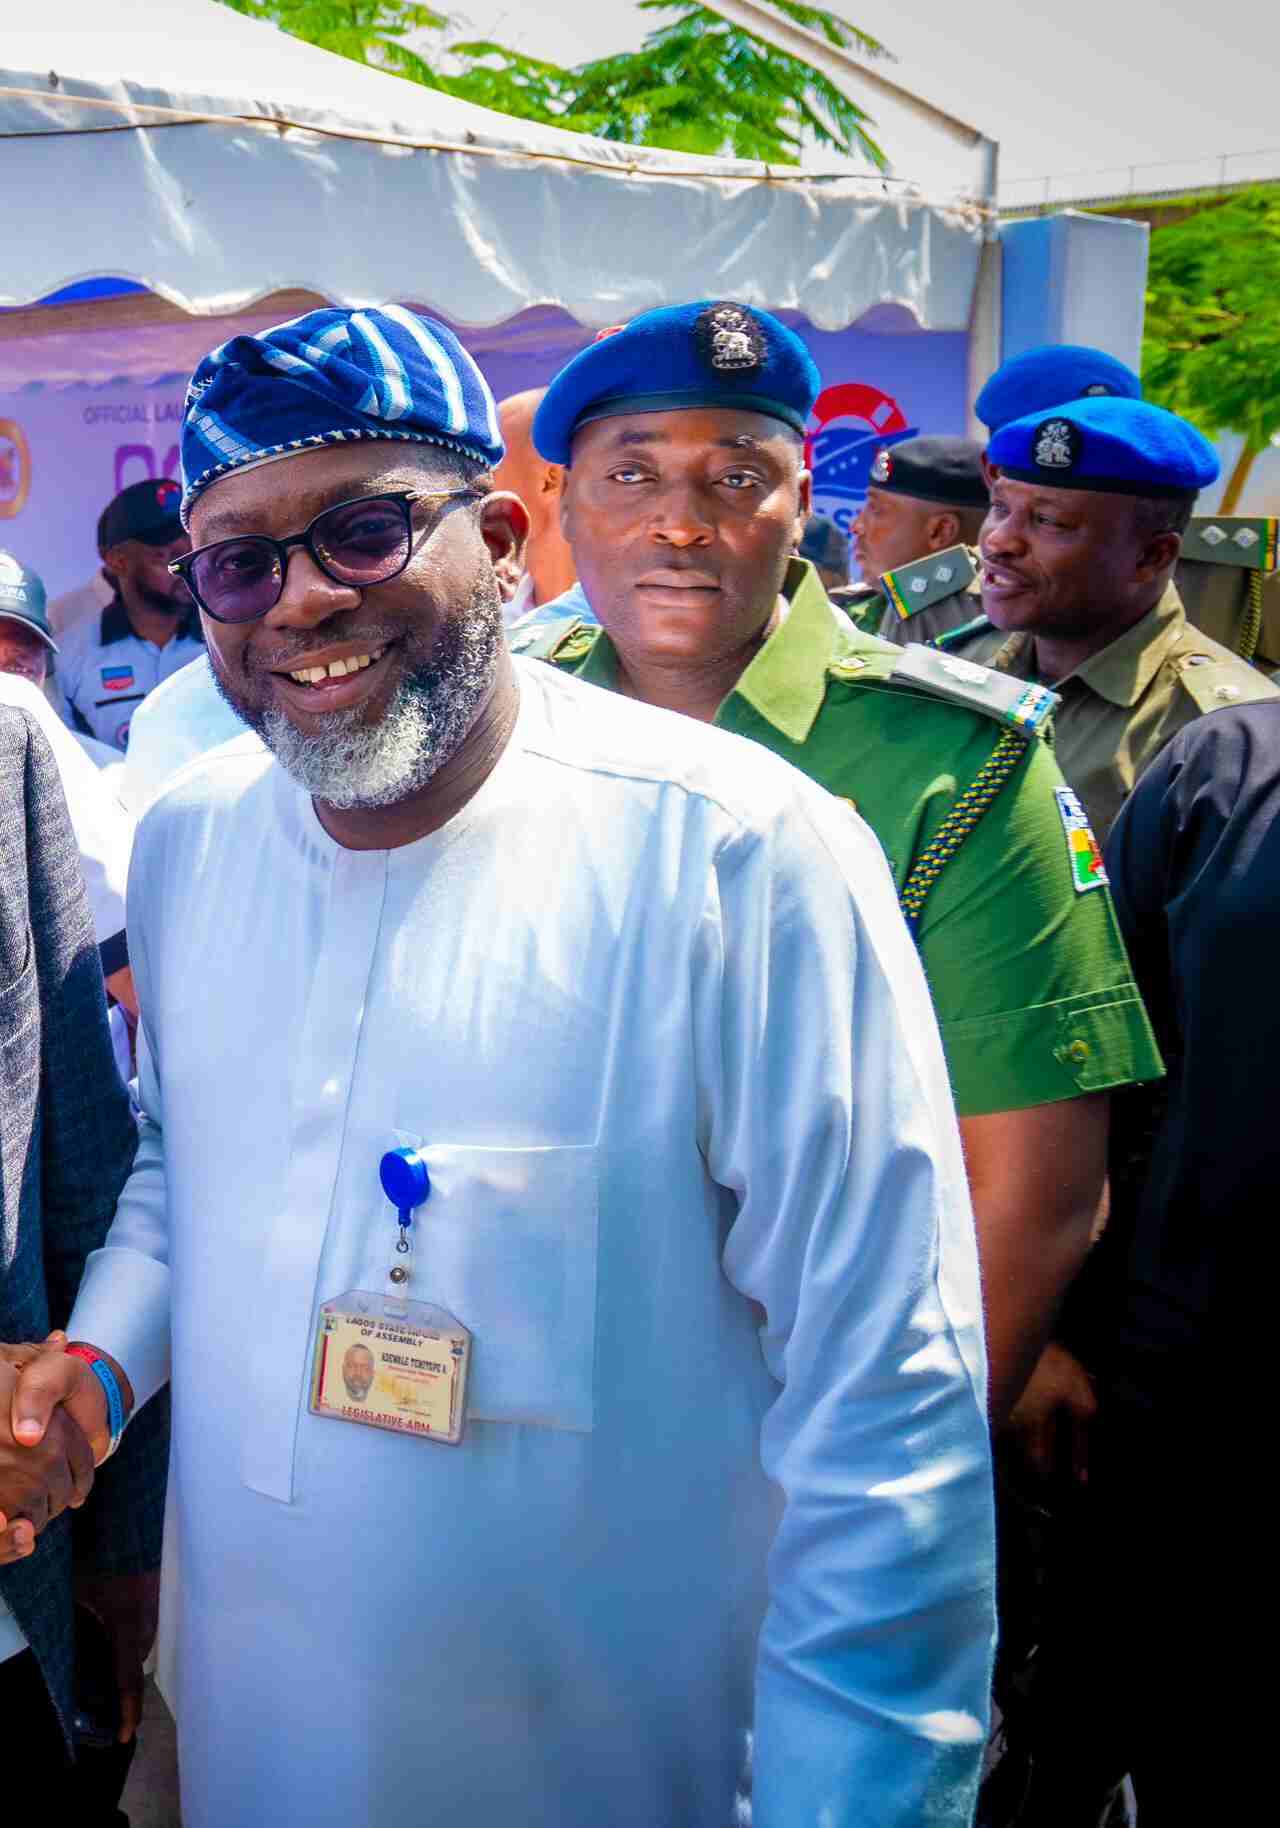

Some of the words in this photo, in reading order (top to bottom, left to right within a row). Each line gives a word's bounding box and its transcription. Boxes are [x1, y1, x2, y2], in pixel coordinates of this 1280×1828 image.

[82, 403, 150, 424] OFFICIAL
[345, 1317, 376, 1329] LAGOS
[360, 1328, 373, 1337] OF
[375, 1331, 423, 1347] ASSEMBLY
